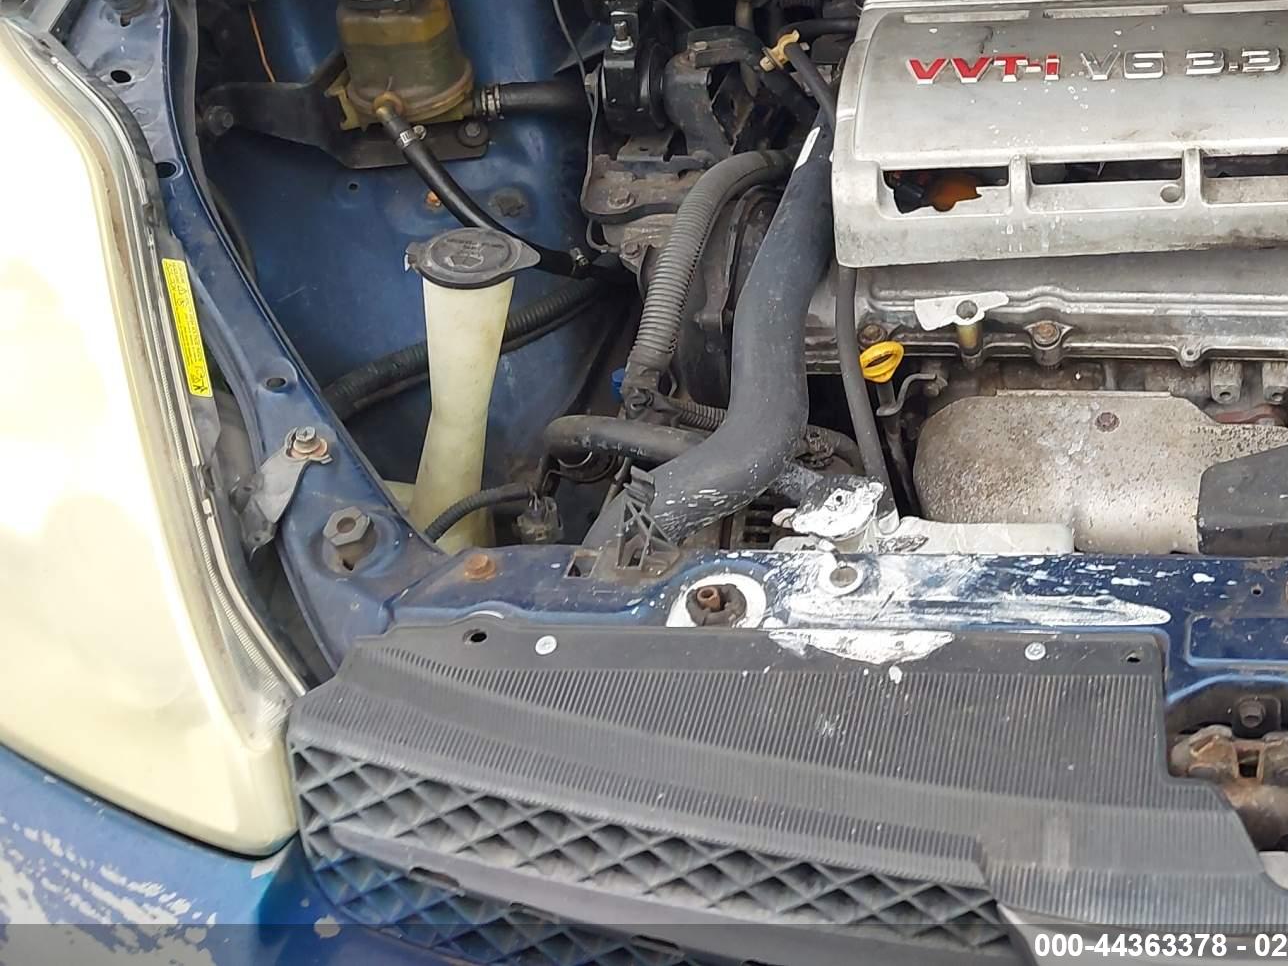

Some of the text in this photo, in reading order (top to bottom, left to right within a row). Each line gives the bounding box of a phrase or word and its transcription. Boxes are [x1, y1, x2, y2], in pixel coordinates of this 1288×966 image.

[906, 47, 1283, 84] VVT-i V6 3.3
